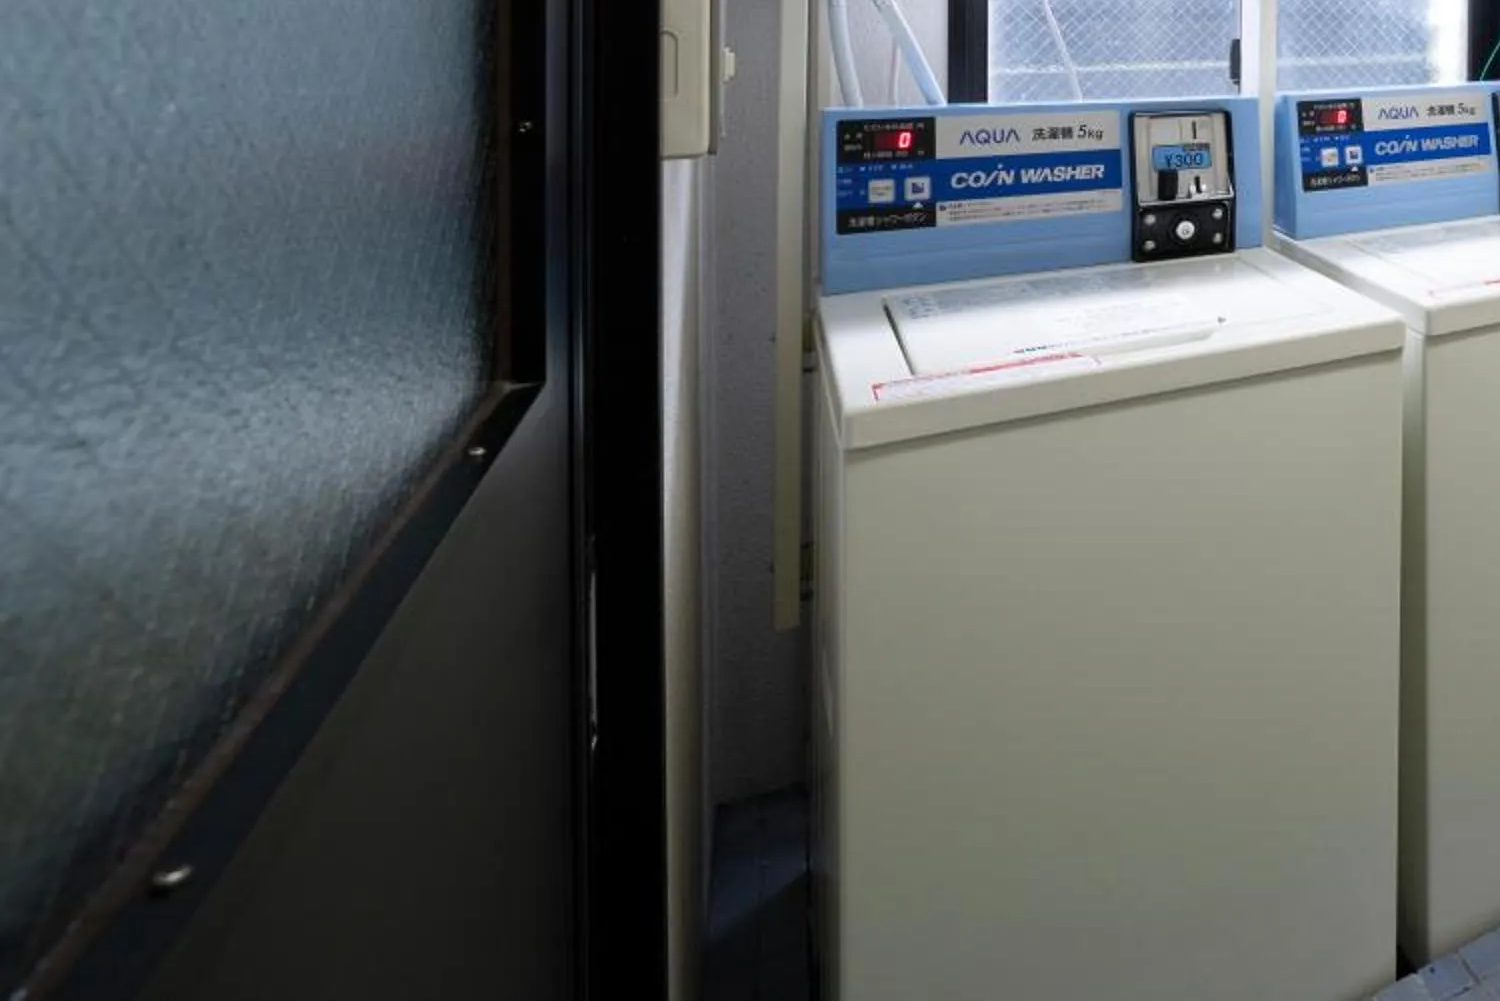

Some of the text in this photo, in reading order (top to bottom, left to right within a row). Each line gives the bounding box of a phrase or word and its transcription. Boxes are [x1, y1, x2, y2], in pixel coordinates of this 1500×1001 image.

[1377, 106, 1420, 120] AQUA
[898, 131, 912, 149] 0
[959, 129, 1021, 146] AQUA
[1076, 123, 1105, 142] 5kg
[1420, 135, 1479, 150] WASHER
[1020, 163, 1105, 184] WASHER
